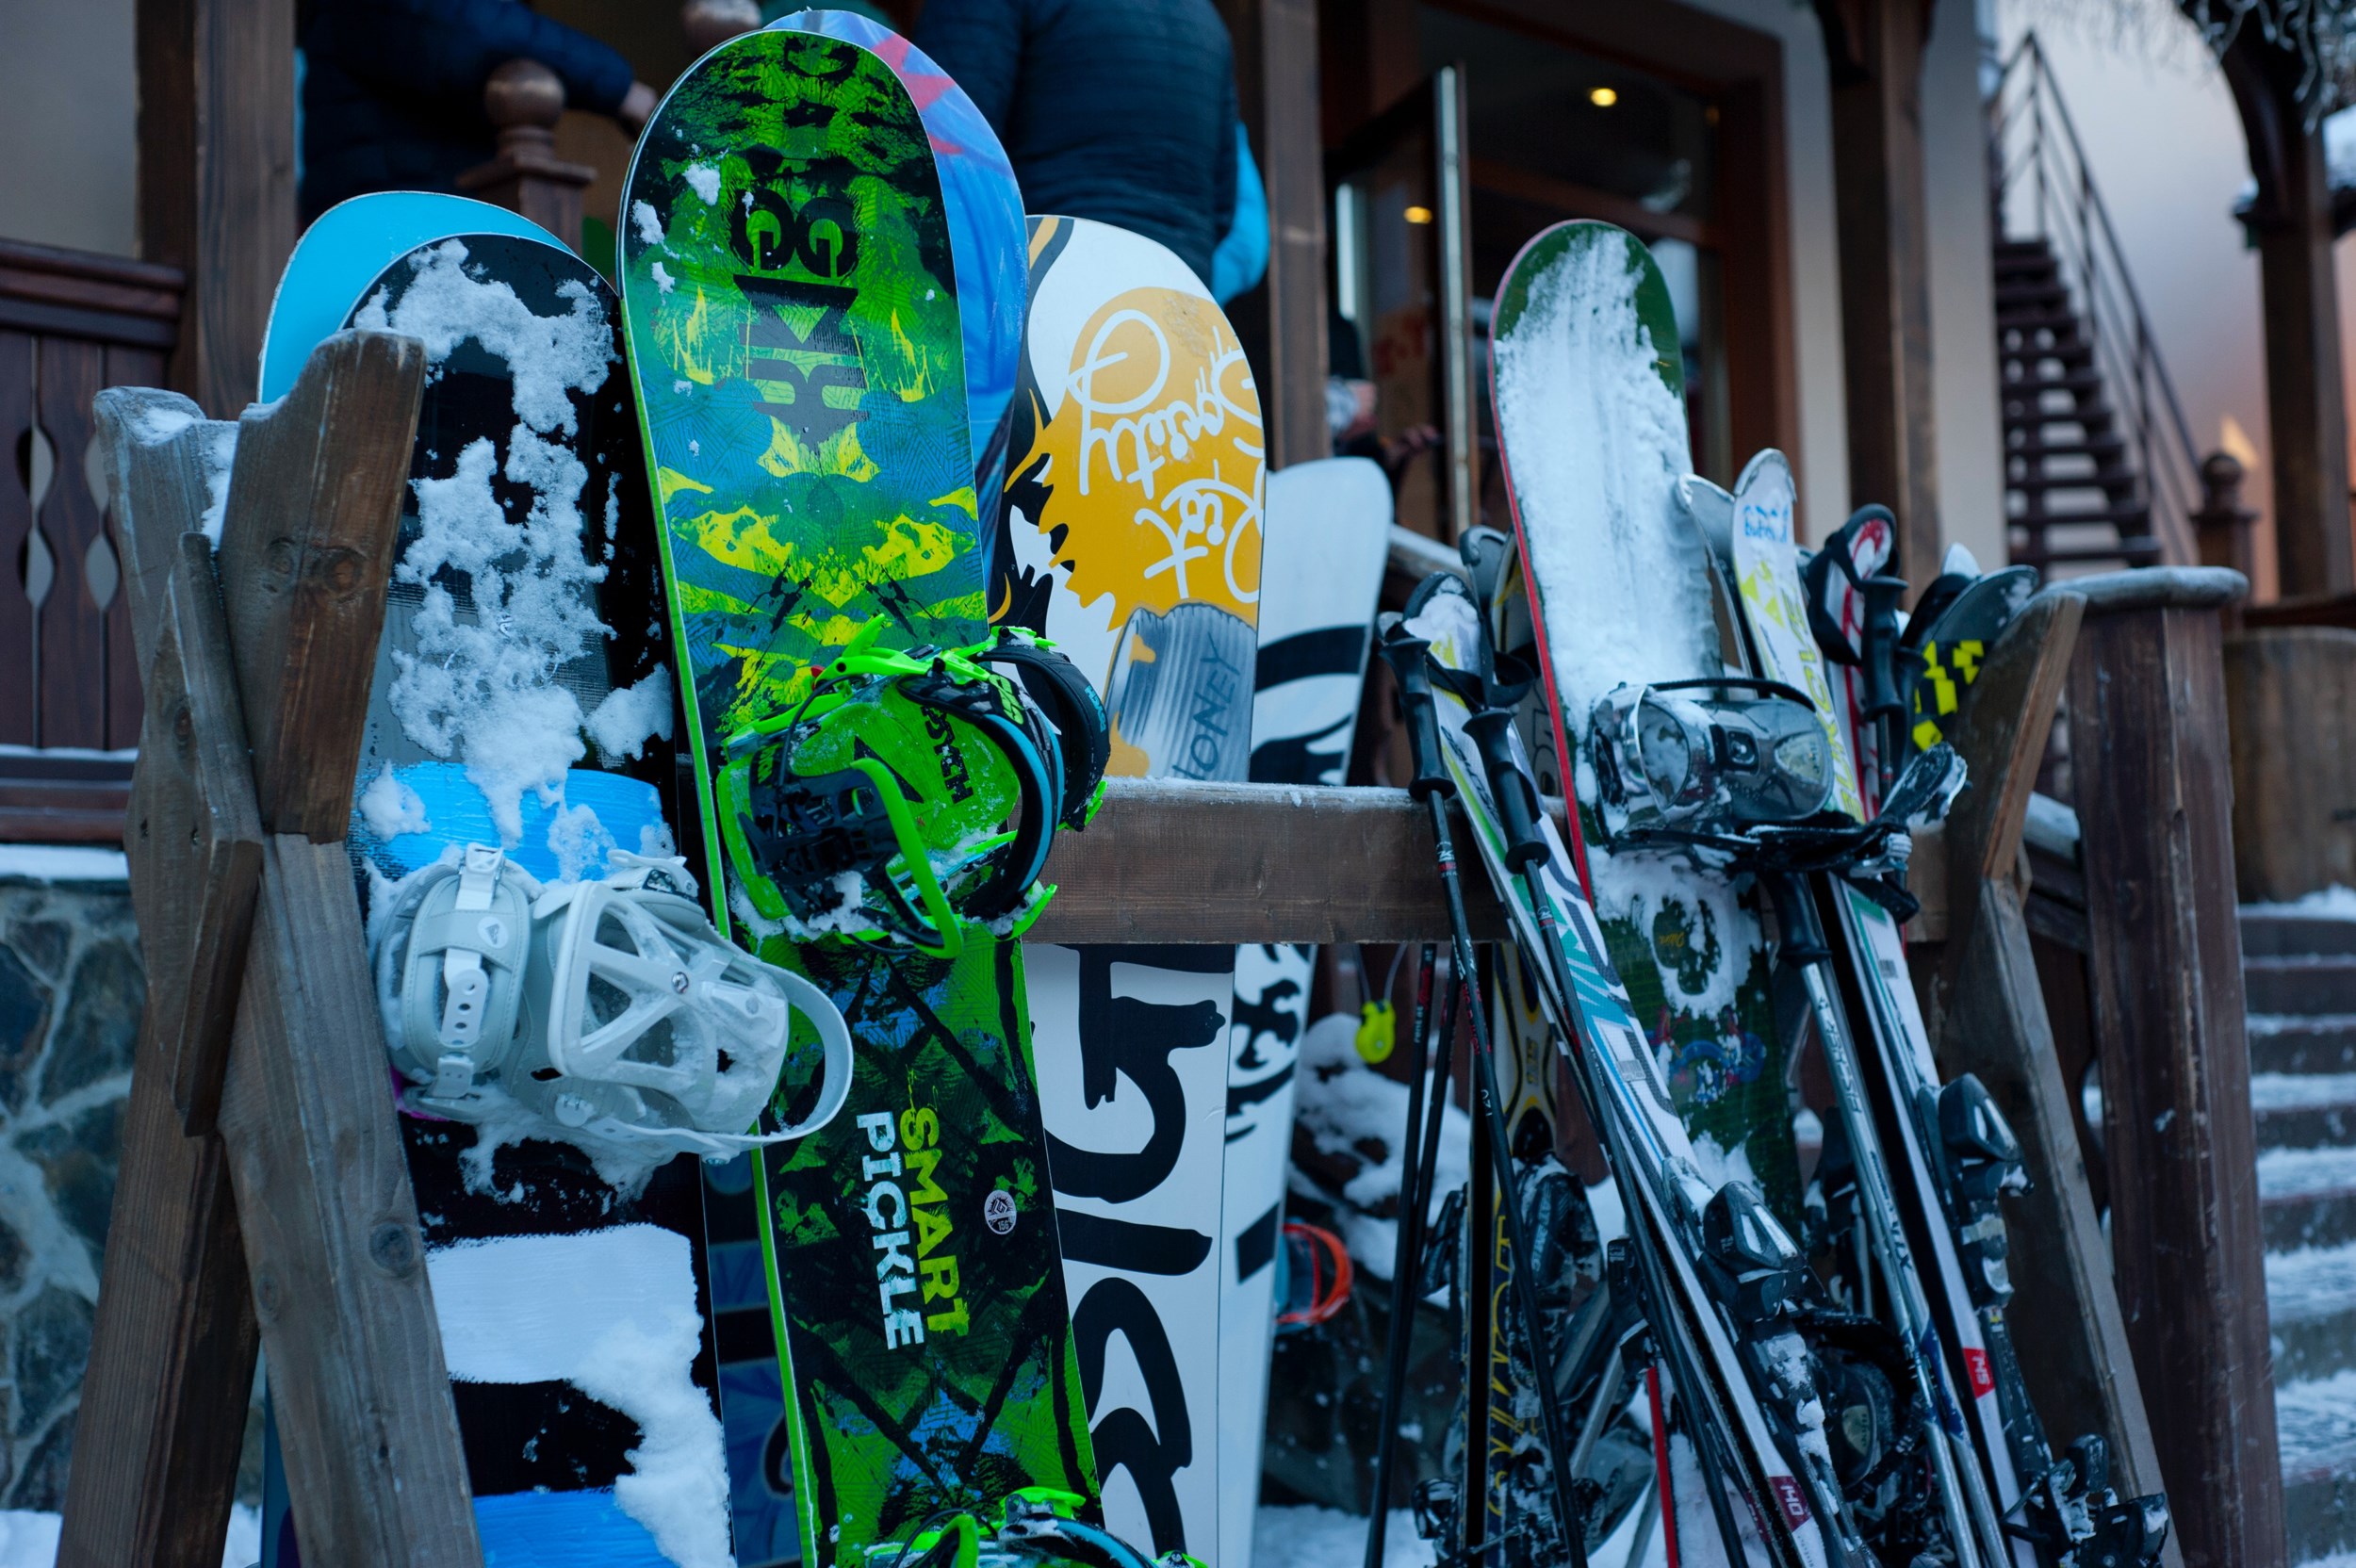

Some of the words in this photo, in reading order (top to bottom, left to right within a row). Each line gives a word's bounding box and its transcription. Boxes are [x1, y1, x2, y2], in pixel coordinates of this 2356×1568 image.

[1068, 309, 1264, 500] Society
[1134, 459, 1264, 605] Riot
[856, 1111, 924, 1350] PICKLE
[900, 1104, 971, 1339] SMART
[997, 1220, 1010, 1232] 156
[1779, 1484, 1806, 1517] 140
